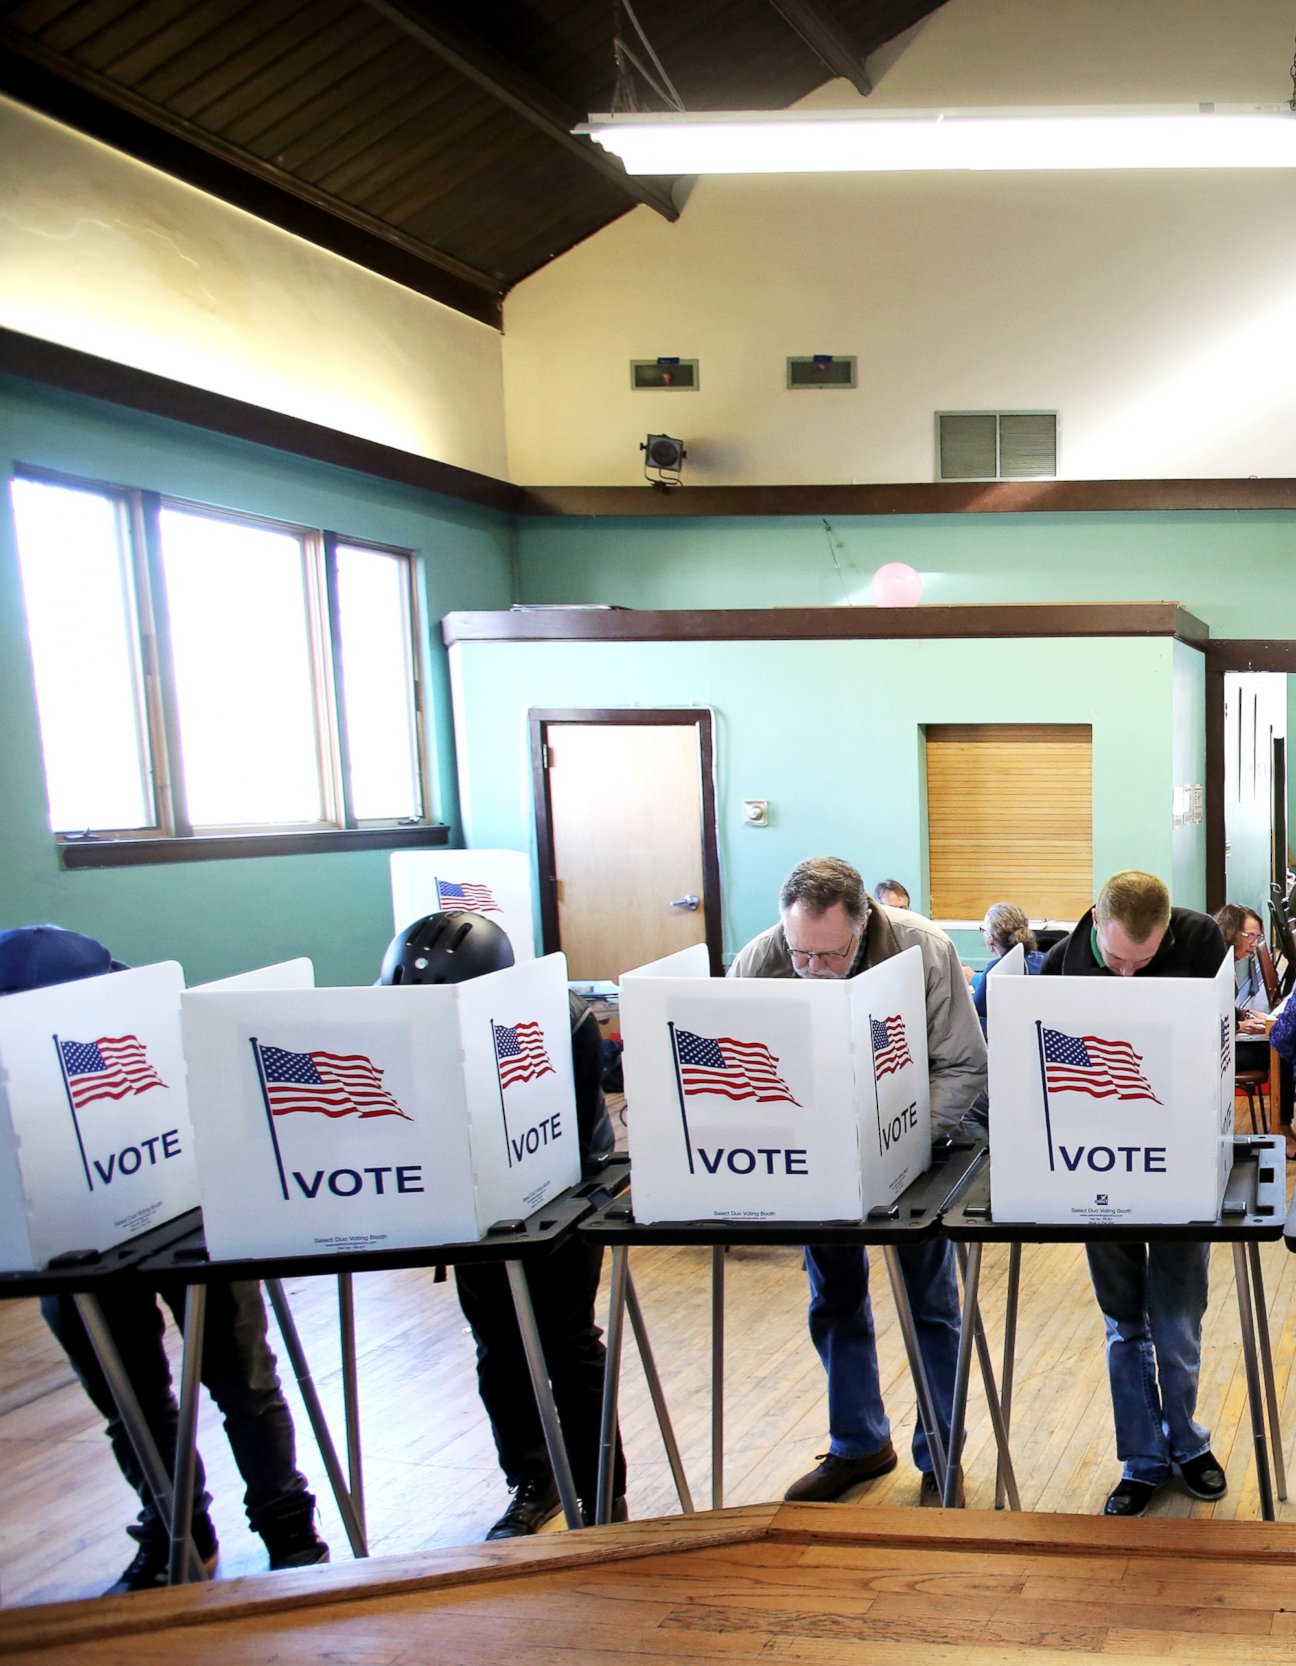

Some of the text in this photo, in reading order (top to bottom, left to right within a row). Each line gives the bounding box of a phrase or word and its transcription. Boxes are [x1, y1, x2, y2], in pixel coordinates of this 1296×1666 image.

[511, 1112, 562, 1162] VOTE
[883, 1101, 918, 1151] VOTE
[92, 1129, 182, 1186] VOTE
[697, 1148, 810, 1175] VOTE
[1058, 1146, 1168, 1173] VOTE
[291, 1165, 425, 1199] VOTE
